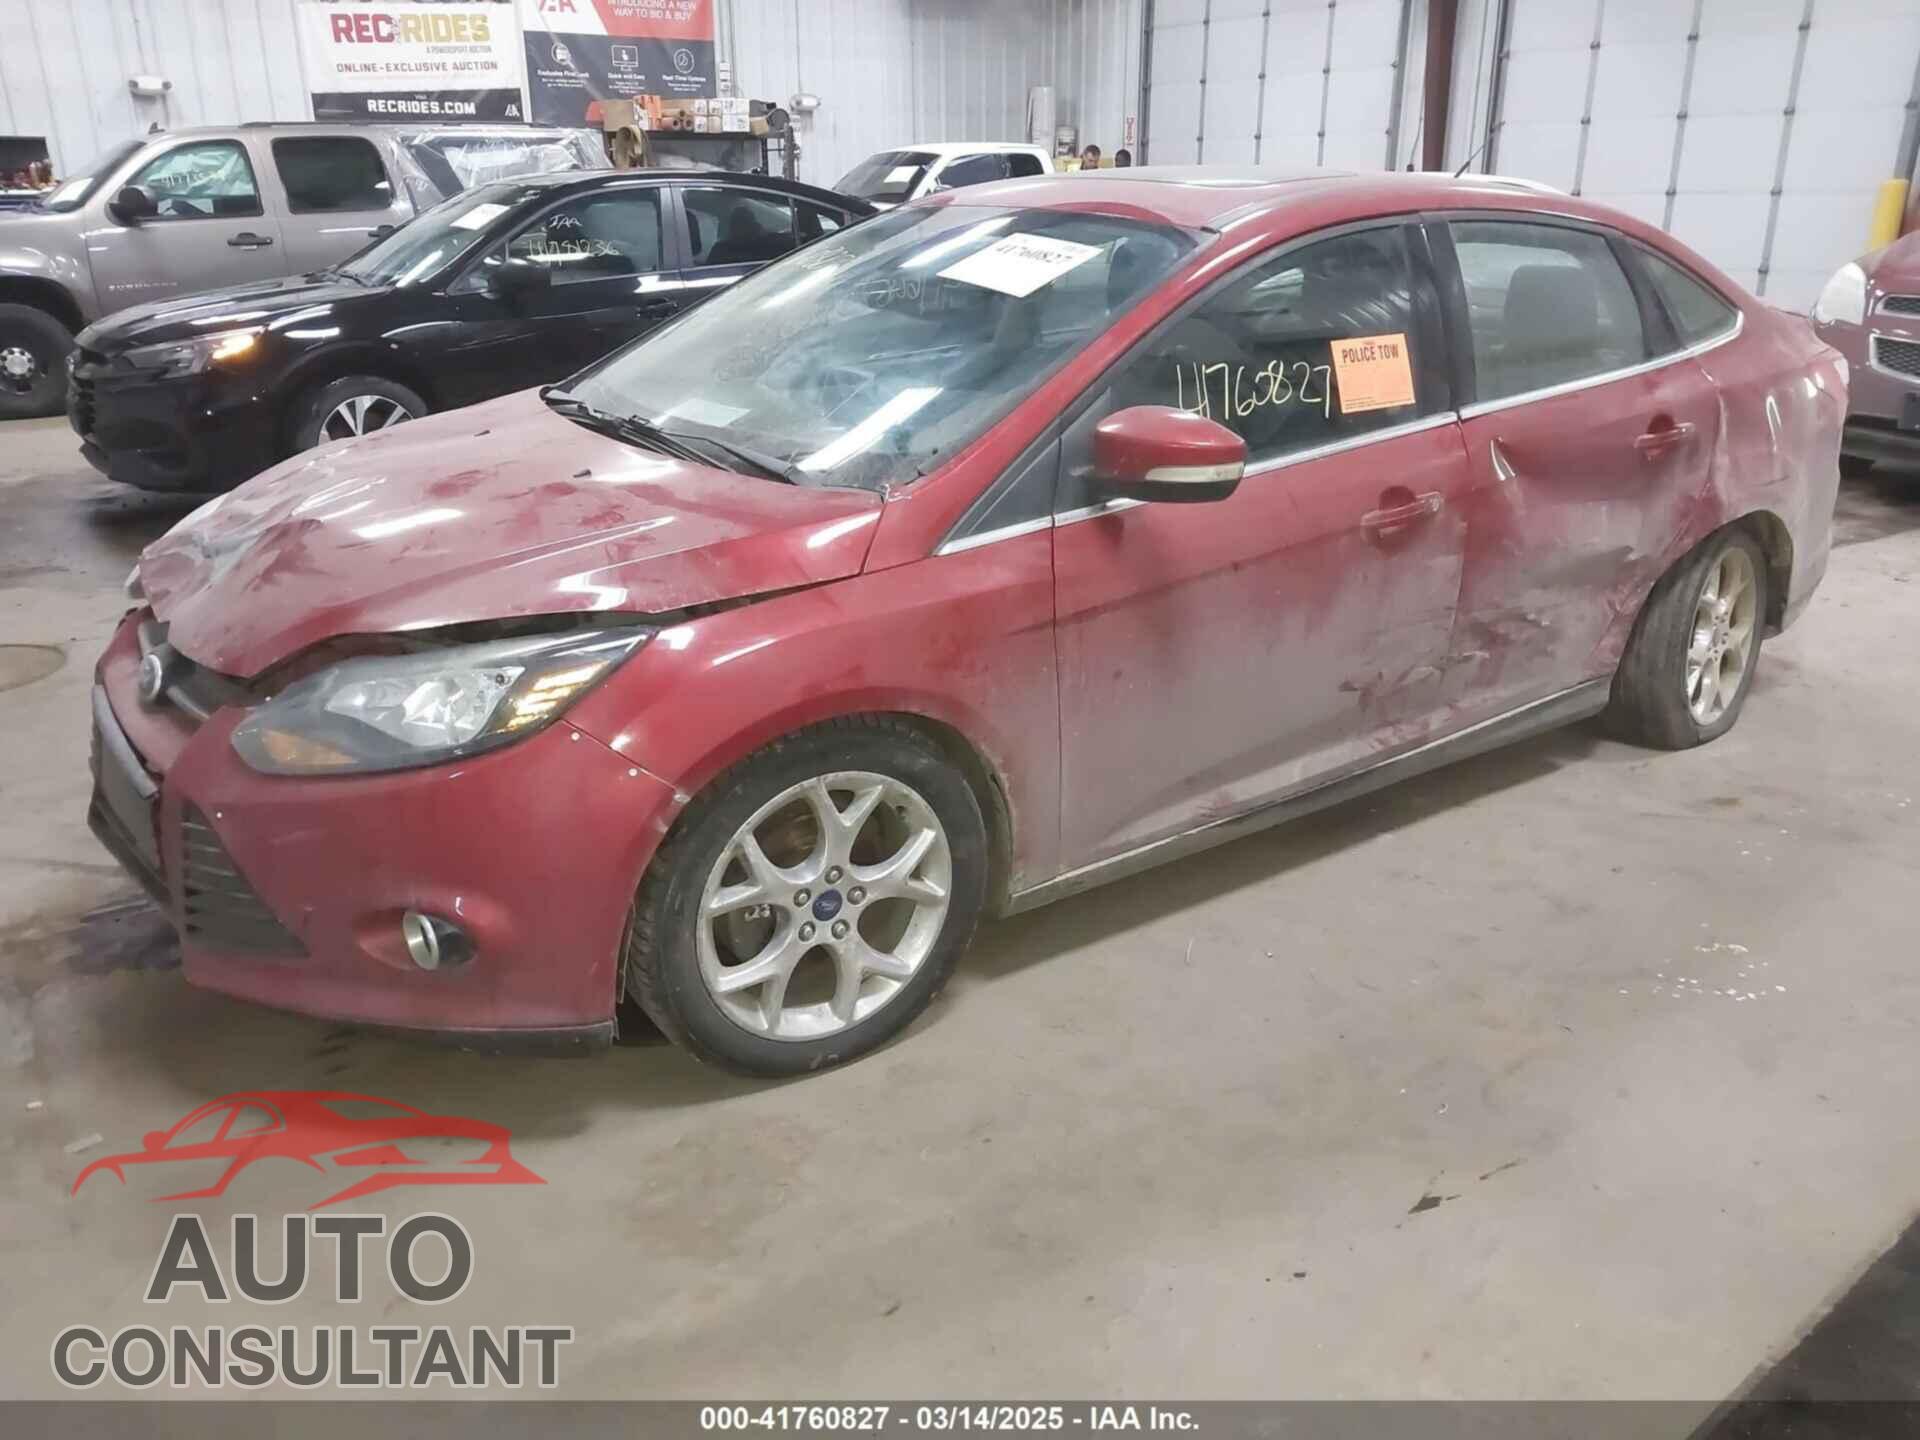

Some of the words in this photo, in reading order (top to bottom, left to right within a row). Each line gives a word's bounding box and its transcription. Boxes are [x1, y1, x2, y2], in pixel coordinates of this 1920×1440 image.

[614, 8, 634, 18] WAY
[635, 10, 648, 18] TO
[674, 13, 692, 21] BUY
[330, 13, 395, 43] REC
[400, 13, 491, 43] RIDES
[336, 62, 448, 73] ONLINE-EXCLUSIVE
[452, 60, 498, 71] AUCTION
[367, 99, 476, 115] RECRIDES.COM
[1342, 345, 1377, 363] POLICE
[1377, 344, 1400, 360] TOW
[1176, 359, 1331, 420] 41760827
